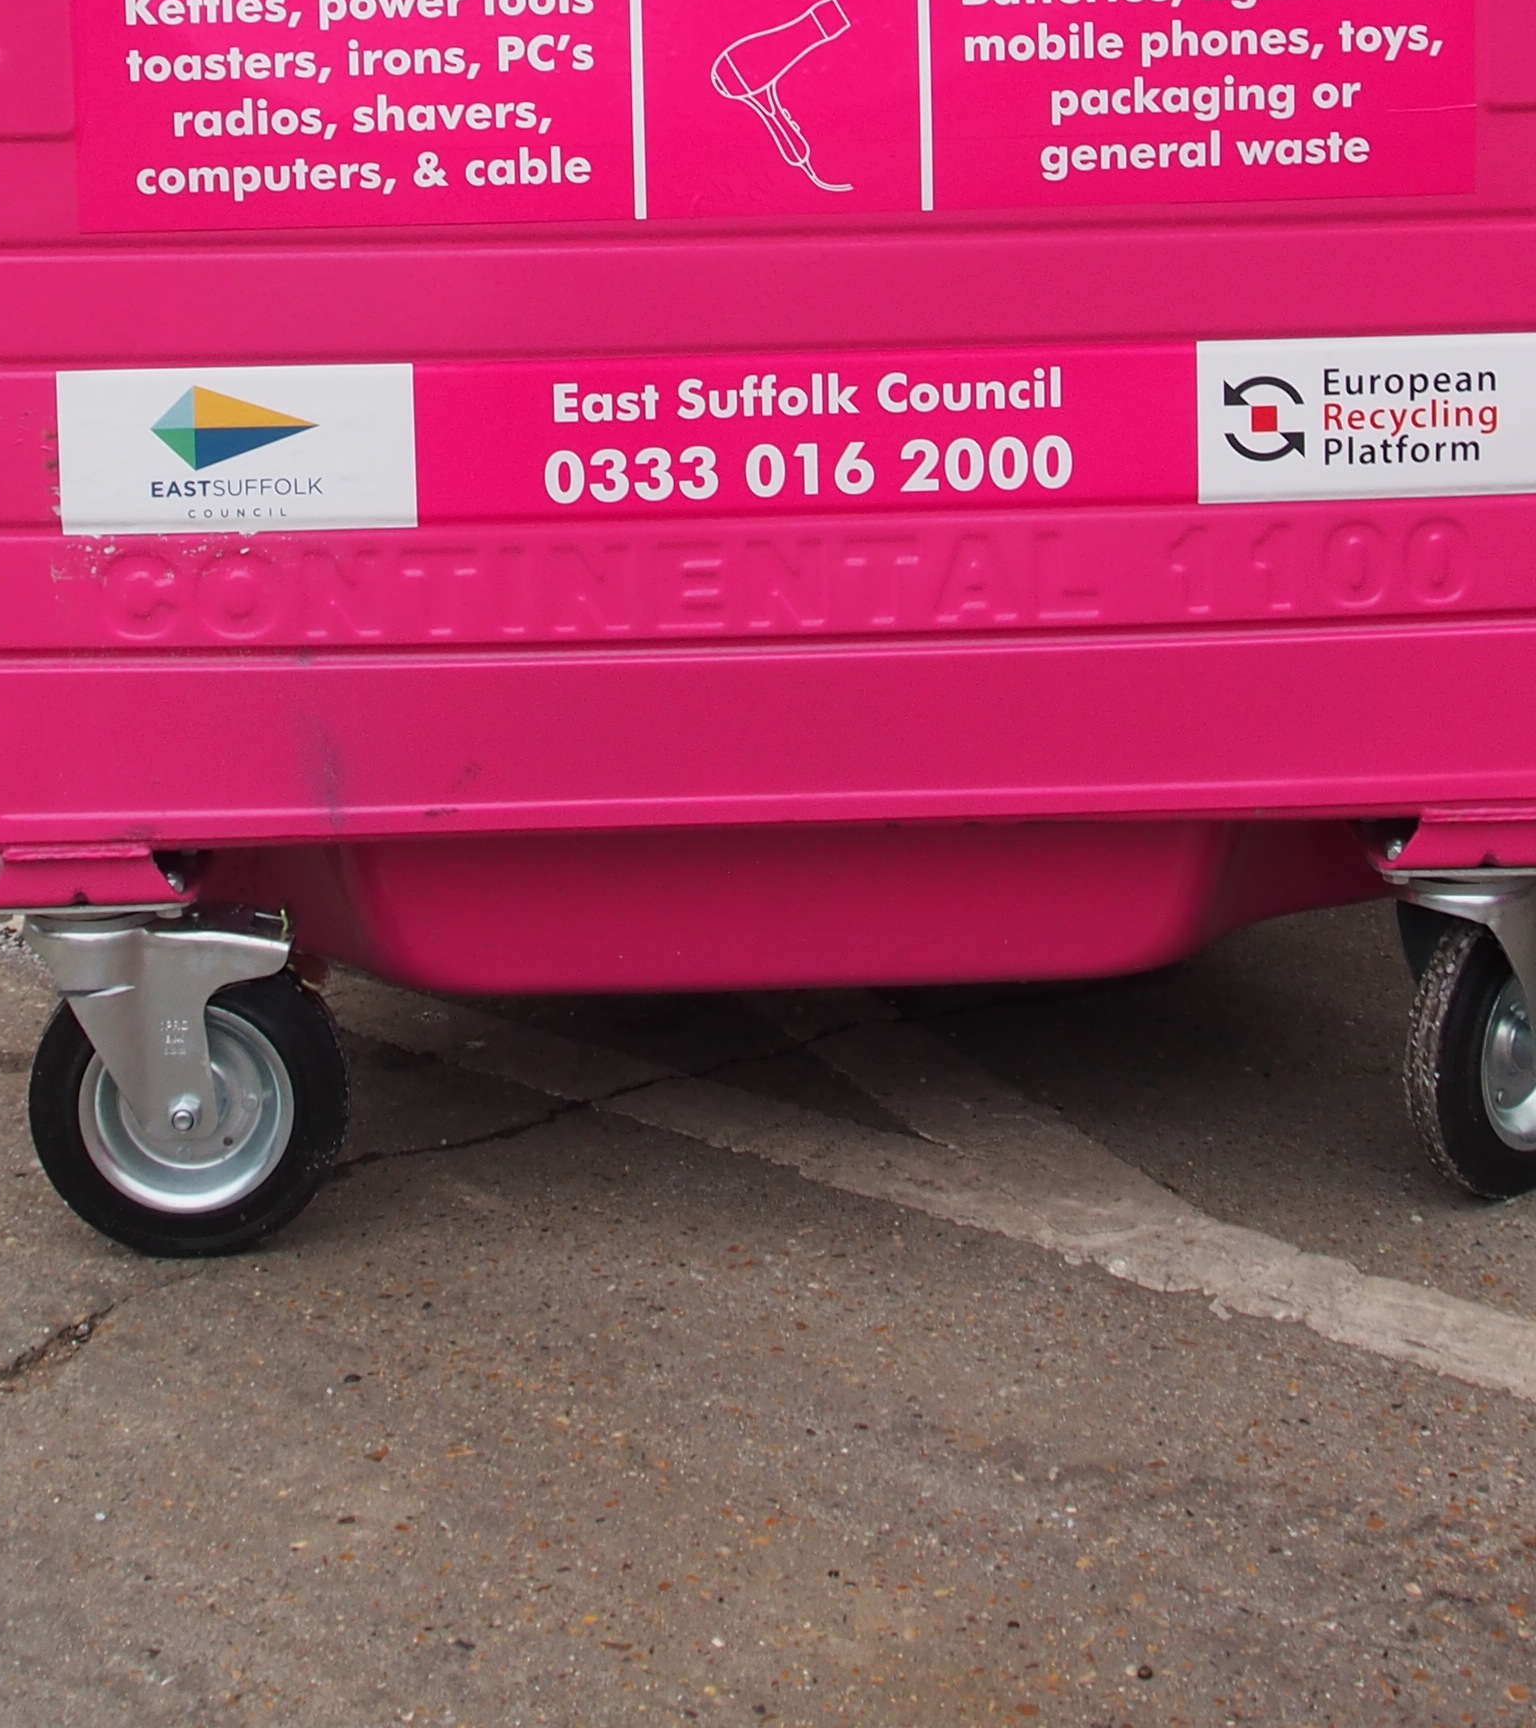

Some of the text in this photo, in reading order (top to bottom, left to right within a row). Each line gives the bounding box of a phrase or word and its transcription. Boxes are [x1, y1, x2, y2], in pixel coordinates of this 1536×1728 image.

[126, 34, 594, 84] toasters, irons, PC's
[964, 19, 1443, 68] mobile phones, toys,
[174, 94, 552, 140] radios, shavers,
[1051, 74, 1361, 126] packaging or
[136, 146, 592, 202] computers, & cable
[1040, 130, 1370, 181] general waste
[553, 366, 1061, 423] East Suffolk Council
[1323, 368, 1497, 402] European
[1323, 399, 1498, 436] Recycling
[544, 435, 1073, 504] 0333 016 2000
[1323, 434, 1480, 466] Platform
[151, 477, 324, 498] EASTSUFFOLK
[188, 508, 287, 519] COUNCIL
[98, 515, 1465, 641] CONTINENTAL 1100
